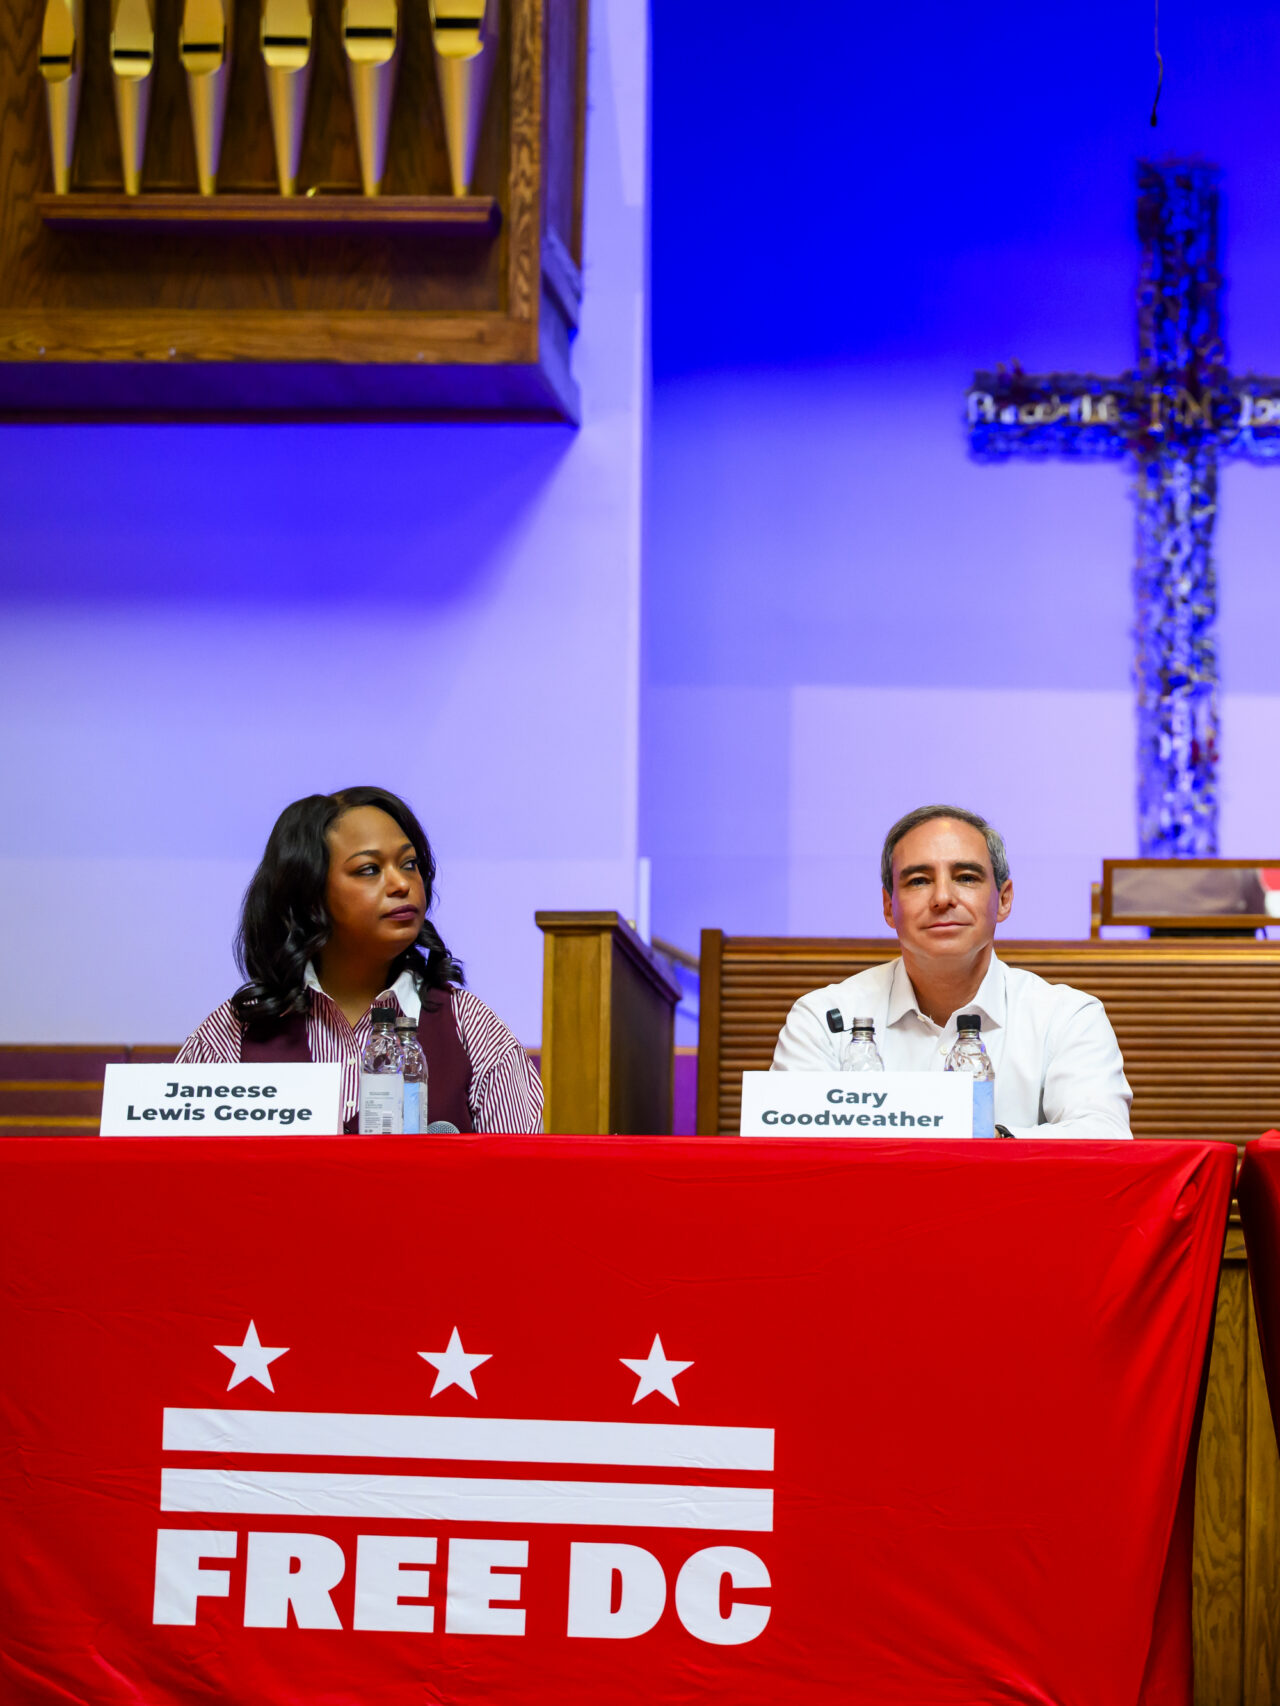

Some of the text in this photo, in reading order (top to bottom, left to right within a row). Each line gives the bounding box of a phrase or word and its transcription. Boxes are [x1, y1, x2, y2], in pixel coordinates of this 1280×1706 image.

[164, 1082, 278, 1099] Janeese
[826, 1088, 888, 1109] Gary
[126, 1103, 313, 1125] Lewis George
[761, 1110, 944, 1127] Goodweather
[152, 1528, 773, 1646] FREE DC
